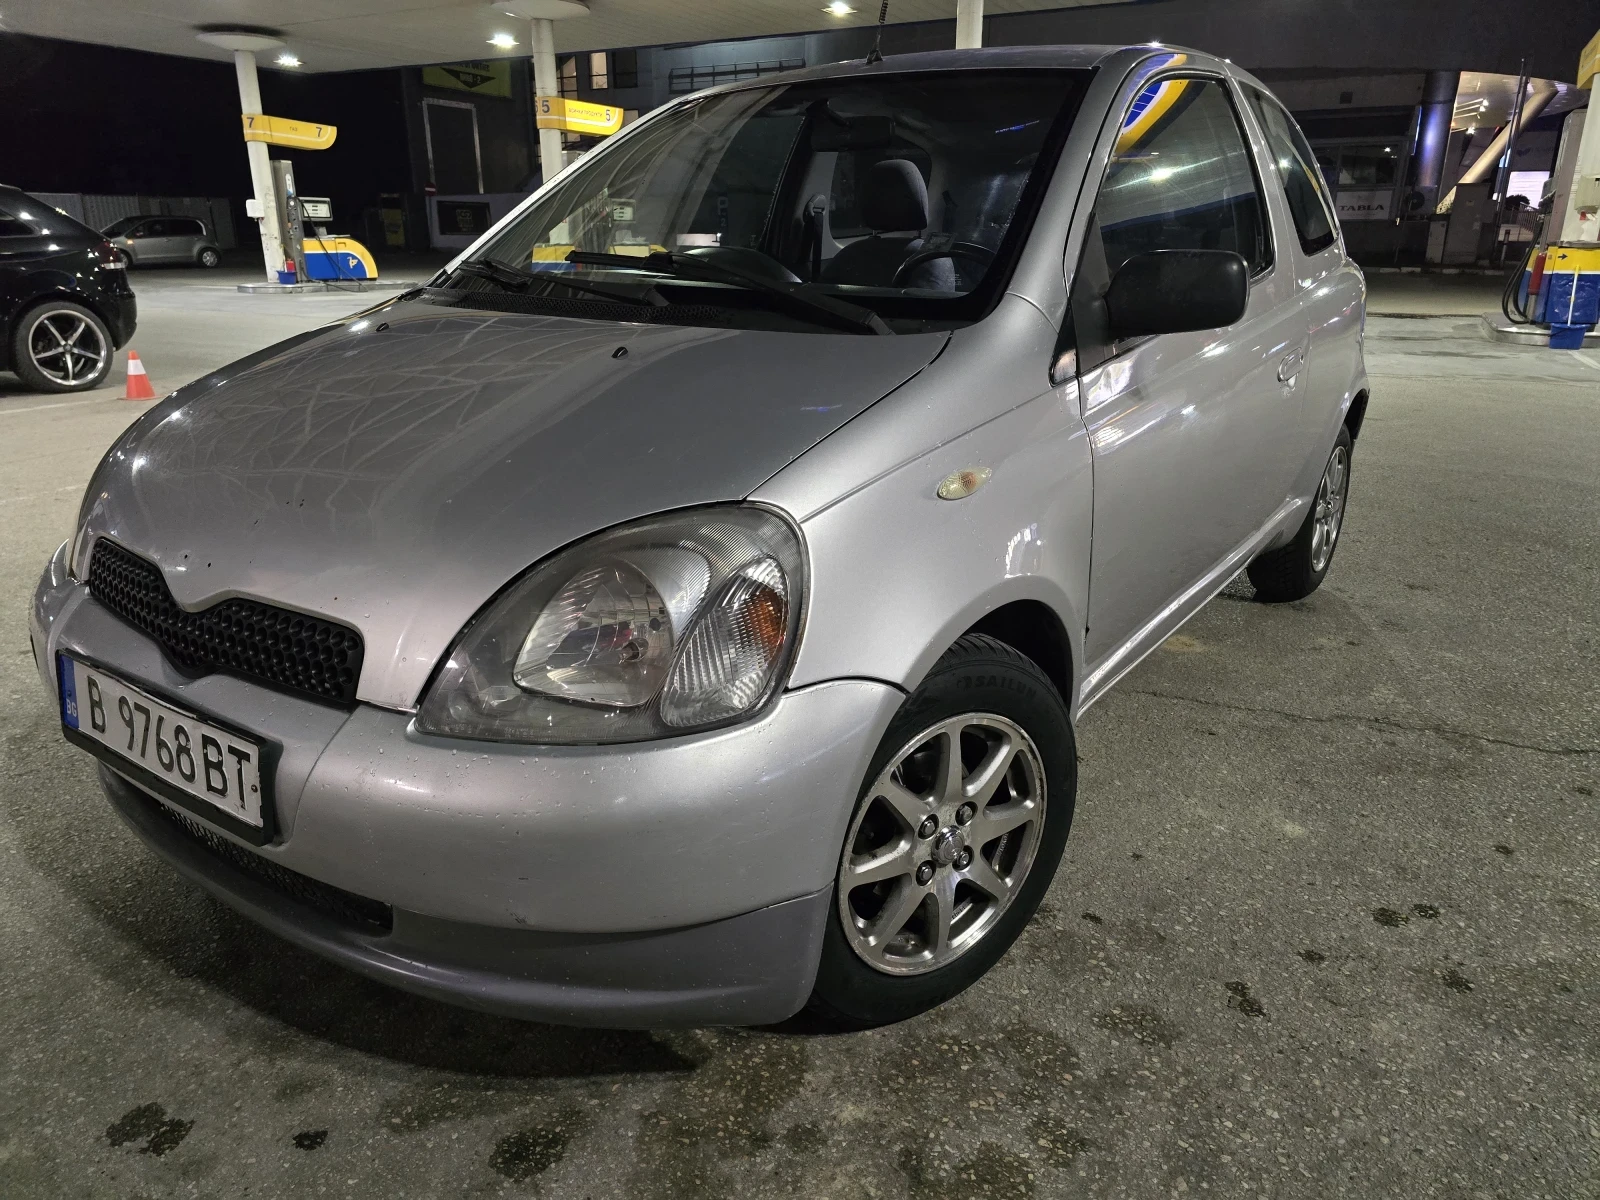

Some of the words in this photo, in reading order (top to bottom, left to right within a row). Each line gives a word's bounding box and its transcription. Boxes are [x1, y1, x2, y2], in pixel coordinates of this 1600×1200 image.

[542, 100, 550, 113] 5
[605, 109, 610, 121] 5
[247, 117, 254, 128] 7
[316, 127, 322, 137] 7
[975, 675, 1037, 700] SAILUN
[66, 698, 78, 718] BG
[87, 675, 107, 734] B
[118, 695, 198, 784] 9768
[202, 732, 251, 811] BT
